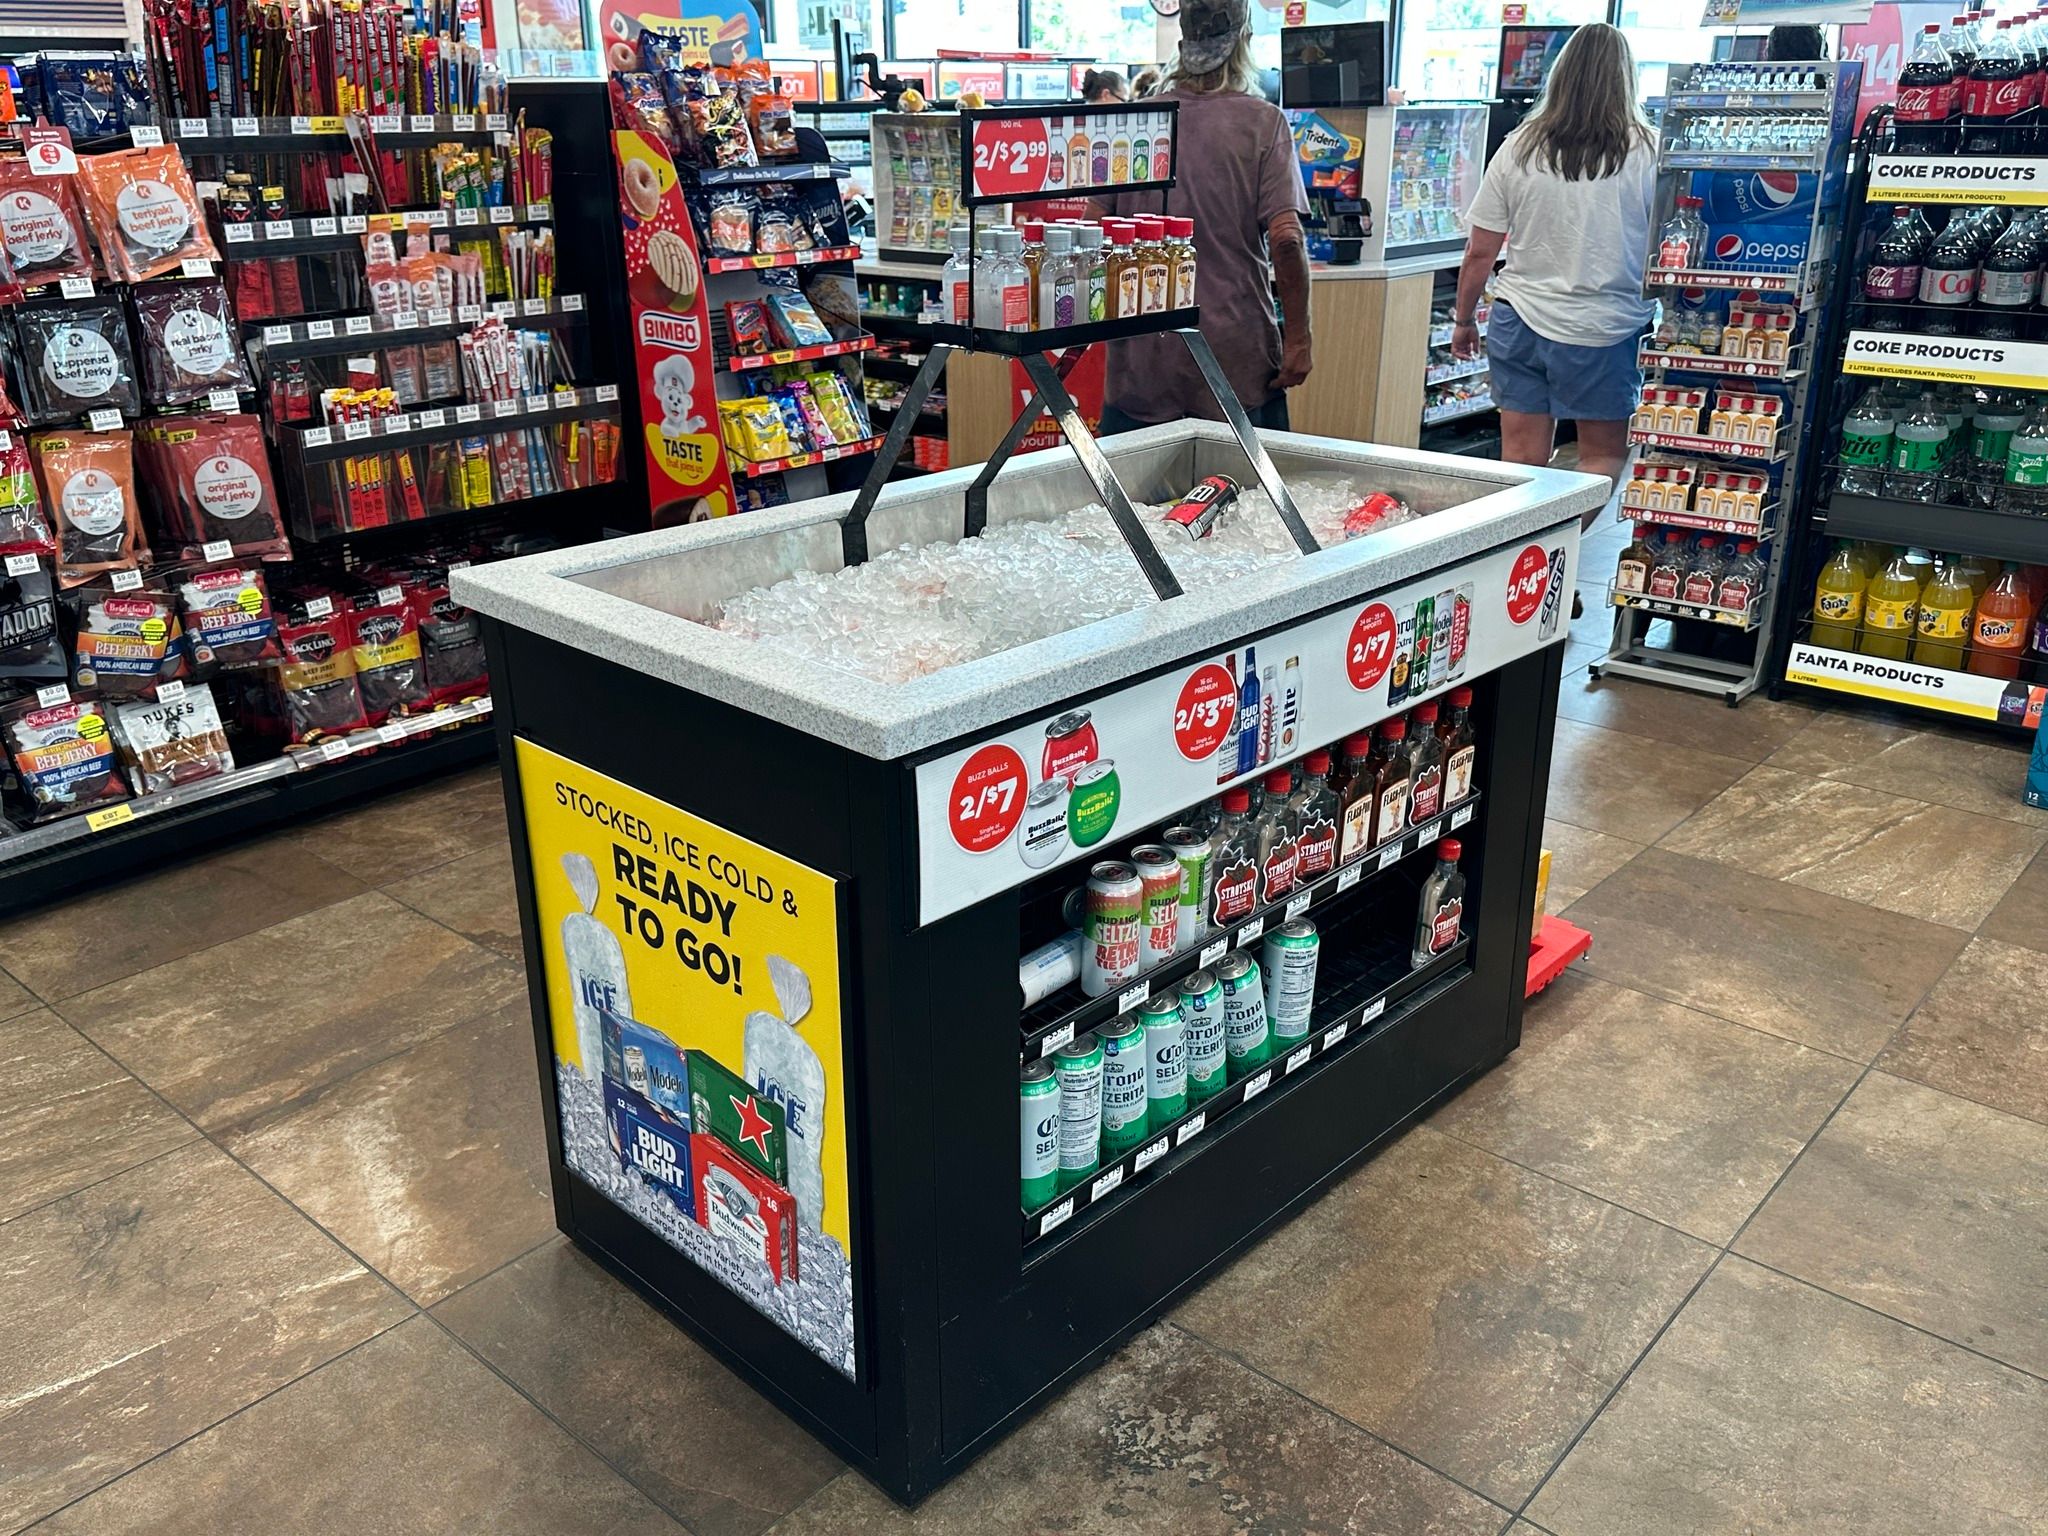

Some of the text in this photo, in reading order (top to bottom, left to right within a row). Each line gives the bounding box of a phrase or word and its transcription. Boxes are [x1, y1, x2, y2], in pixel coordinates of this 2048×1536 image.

[657, 26, 709, 47] TASTE
[1897, 89, 1935, 111] Cola
[1001, 120, 1022, 128] 100 mL
[1305, 129, 1340, 149] Trident
[1878, 163, 2036, 181] COKE PRODUCTS
[1733, 178, 1752, 213] pepsi
[1902, 191, 1940, 199] (EXCLUDES
[1965, 193, 2006, 201] PRODUCTS)
[131, 204, 174, 221] teriyaki
[10, 217, 54, 234] original
[129, 213, 184, 234] beef jerky
[36, 228, 63, 243] jerky
[1745, 241, 1807, 261] pepsi
[67, 279, 88, 288] $6.79
[1866, 266, 1897, 288] Cola
[643, 318, 698, 344] BIMBO
[1853, 339, 2005, 363] COKE PRODUCTS
[53, 355, 109, 370] peppered
[55, 363, 113, 380] beef jerky
[1854, 364, 1876, 372] LITERS
[1876, 366, 1913, 376] (EXCLUDES
[1914, 369, 1935, 378] FANTA
[1936, 371, 1976, 381] PRODUCTS)
[663, 438, 703, 463] TASTE
[1021, 437, 1054, 450] you'll
[204, 489, 256, 504] beef jerky
[208, 480, 248, 493] original
[13, 557, 35, 565] $6.99
[116, 574, 137, 582] $9.09
[108, 604, 151, 615] Bridgford
[1820, 597, 1849, 612] Fanta
[2, 602, 55, 638] ADOR
[201, 614, 226, 630] BEEF
[1363, 619, 1382, 632] IMPORTS
[1452, 605, 1460, 655] ARTOIS
[1457, 607, 1466, 653] STELLA
[1980, 623, 2011, 637] Fanta
[206, 627, 260, 643] 100% AMERICAN BEEF
[96, 641, 155, 656] BEEF JERKY
[289, 642, 312, 655] JACK
[1352, 630, 1391, 664] 2/$7
[95, 660, 153, 670] 100% AMERICAN BEEF
[1796, 652, 1945, 689] FANTA PRODUCTS
[1194, 682, 1219, 695] PREMIUM
[1797, 675, 1818, 683] LITERS
[45, 686, 65, 695] $9.09
[143, 703, 195, 724] DUKE'S
[1240, 704, 1258, 720] BUD
[1258, 693, 1272, 761] Coors
[36, 744, 97, 769] BEEF JERKY
[44, 762, 102, 783] 100% AMERICAN BEEF
[967, 762, 1009, 784] BUZZ BALLS
[959, 776, 1018, 822] 2/$7
[102, 810, 119, 819] EBT
[1028, 811, 1067, 835] BuzzBallz
[555, 781, 799, 918] STOCKED, ICE COLD &
[1301, 838, 1332, 857] STROYSKI
[1268, 855, 1295, 878] STROYSKI
[612, 842, 737, 937] READY
[1221, 880, 1254, 900] STROYSKI
[1095, 915, 1118, 925] BUD
[615, 893, 743, 996] TO GO!
[1095, 956, 1117, 970] TIE
[579, 968, 617, 1013] ICE
[650, 1065, 685, 1095] Modelo
[1102, 1066, 1144, 1086] rona
[617, 1098, 626, 1109] 12
[758, 1066, 806, 1139] ICE
[1102, 1085, 1144, 1103] TZERITA
[638, 1126, 677, 1163] BUD
[632, 1143, 685, 1188] LIGHT
[766, 1197, 778, 1213] 16
[711, 1201, 761, 1250] Budweiser
[651, 1202, 745, 1277] Check Out Our Variety
[640, 1205, 761, 1299] of Larger Packs in the Cooler
